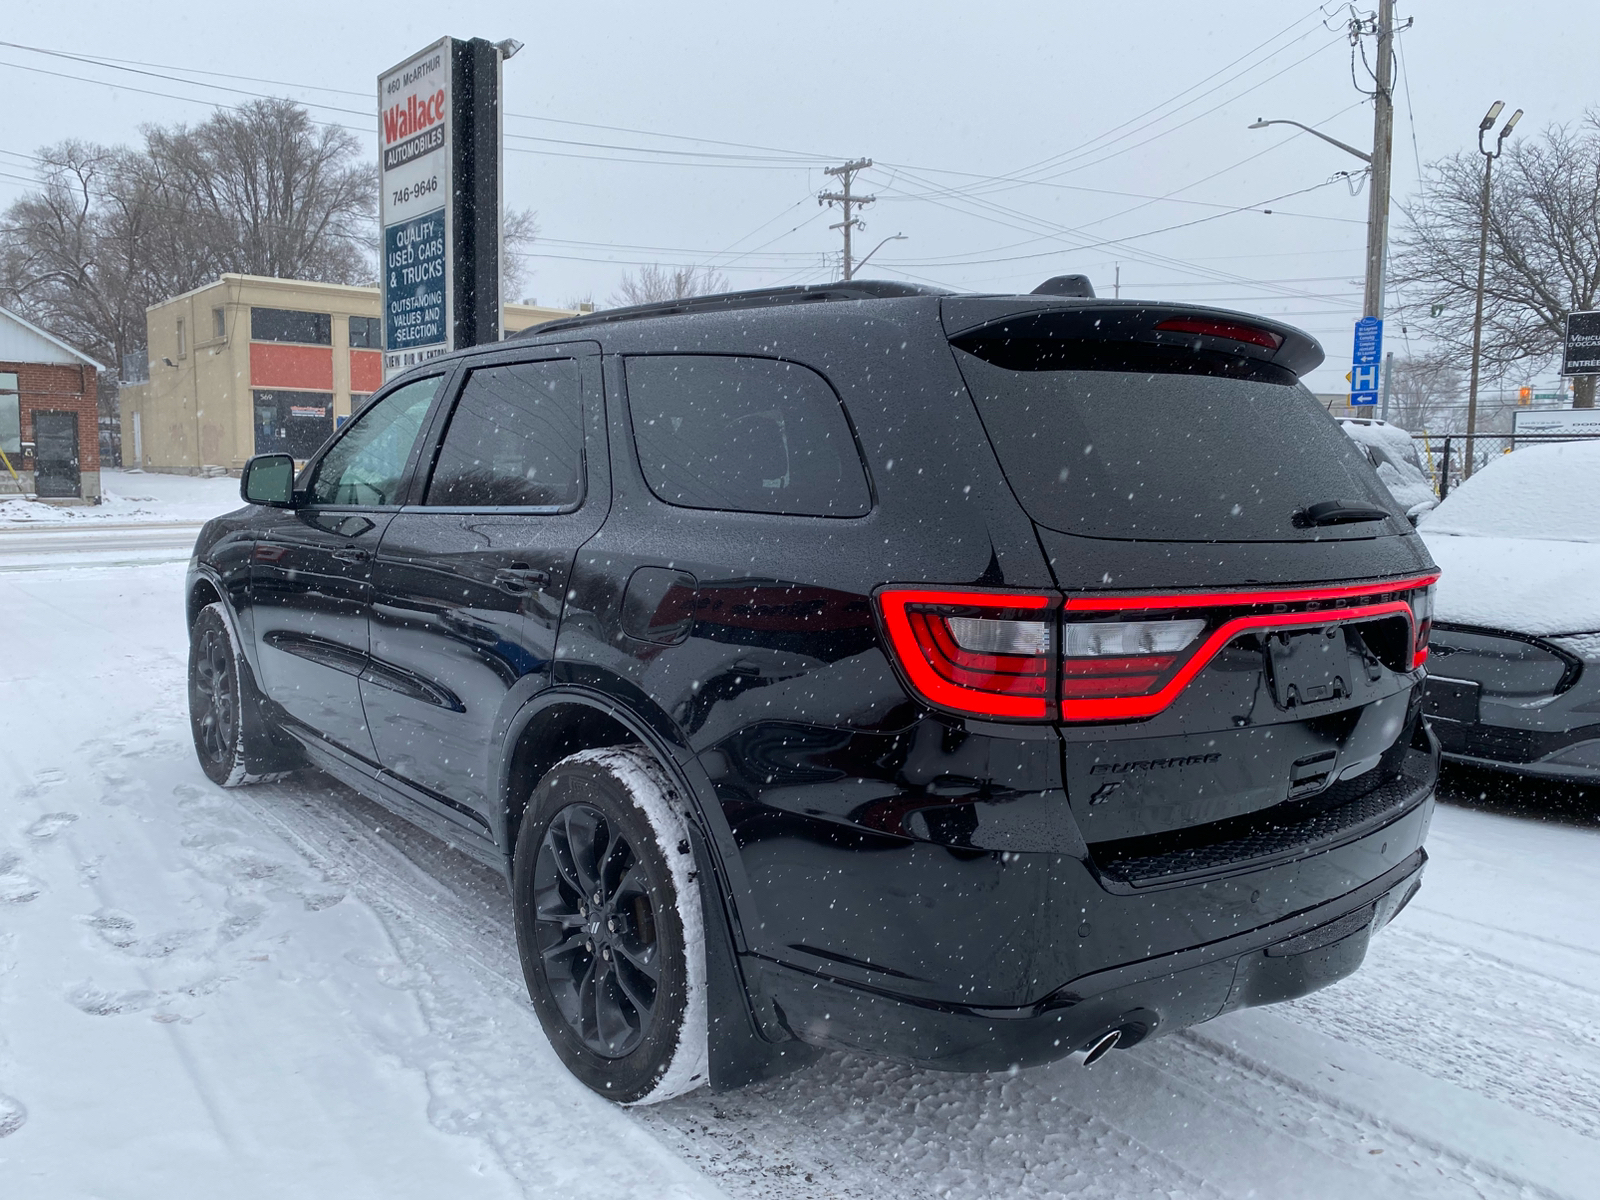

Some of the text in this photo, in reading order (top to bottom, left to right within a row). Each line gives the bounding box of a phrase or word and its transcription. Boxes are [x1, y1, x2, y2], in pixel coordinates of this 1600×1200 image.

[387, 55, 441, 96] 460 McARTHUR
[383, 88, 445, 145] Wallace
[387, 127, 443, 166] AUTOMOBILES
[392, 175, 438, 206] 746-9646
[396, 221, 435, 247] QUALITY
[389, 238, 443, 268] USED CARS
[390, 259, 443, 288] & TRUCKS
[391, 290, 442, 314] OUTSTANDING
[393, 307, 440, 328] VALUES AND
[396, 324, 437, 342] SELECTION
[1355, 367, 1376, 390] H
[1272, 593, 1390, 614] DODGE
